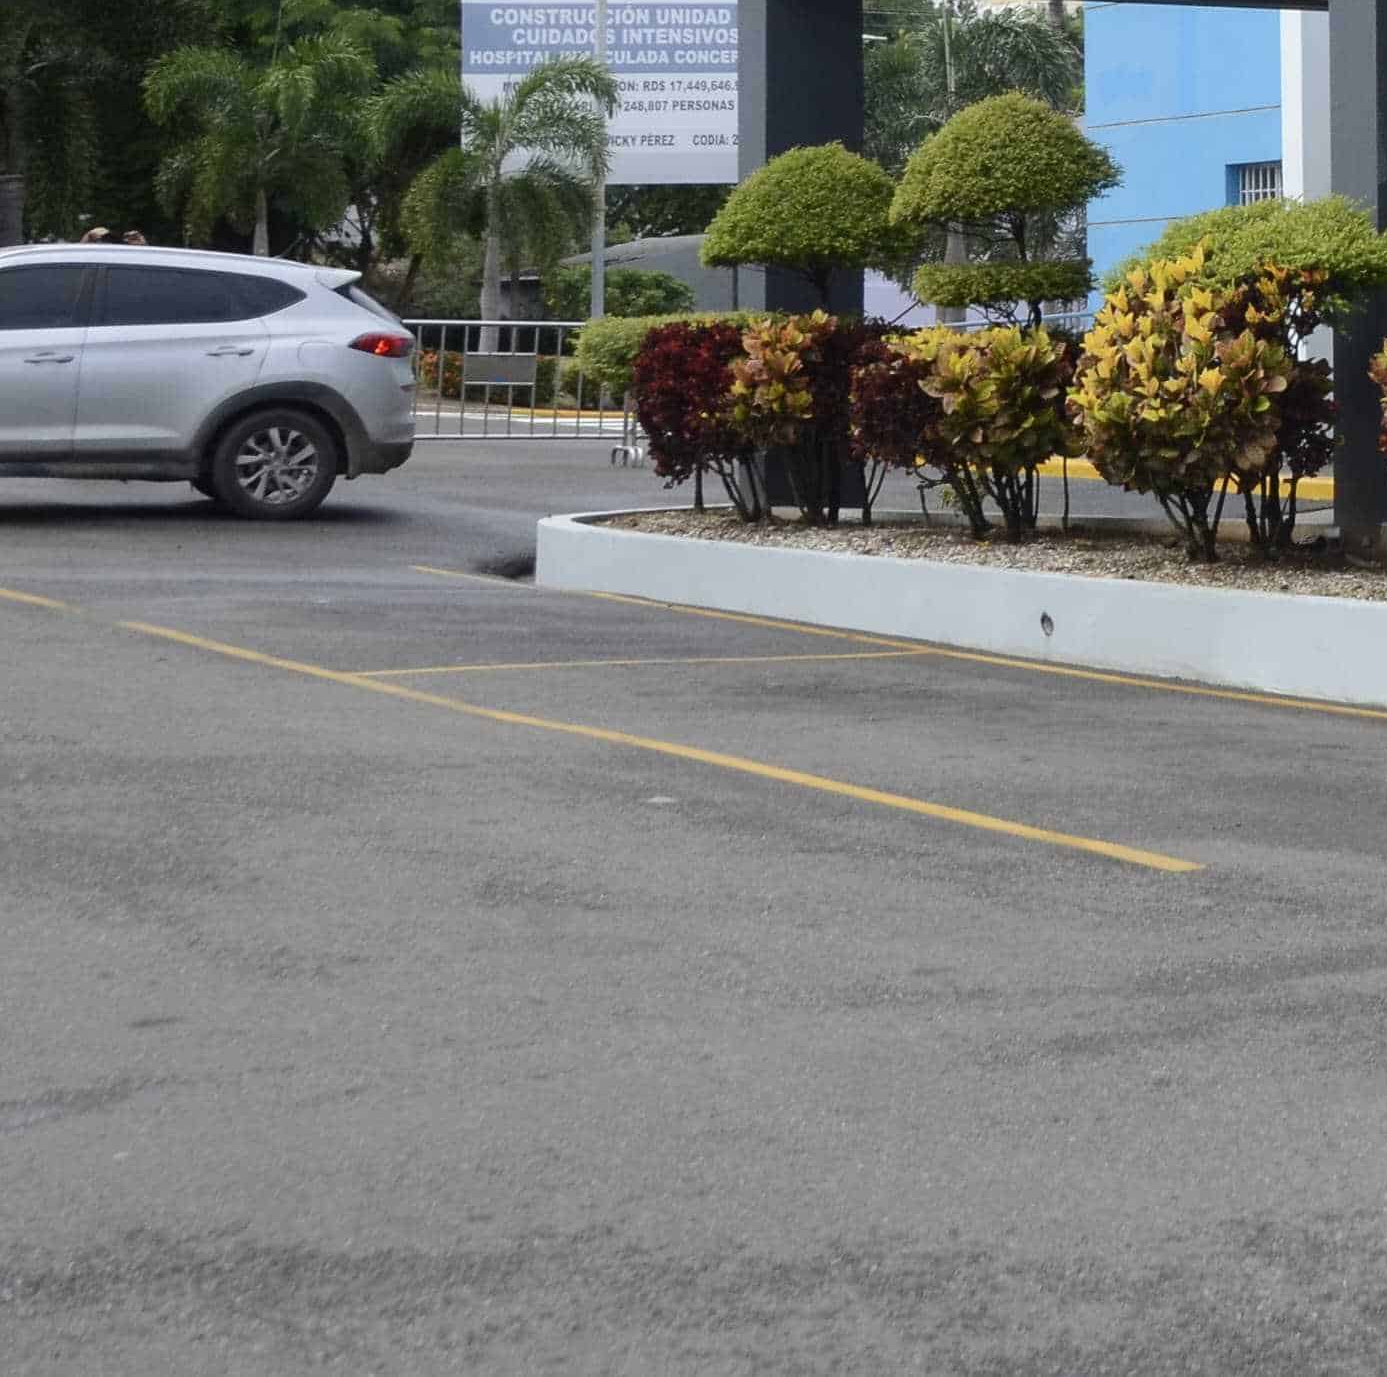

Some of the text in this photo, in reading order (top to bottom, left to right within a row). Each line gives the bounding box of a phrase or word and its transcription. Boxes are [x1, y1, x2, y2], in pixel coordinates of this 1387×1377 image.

[657, 8, 731, 25] UNIDAD
[623, 28, 738, 45] INTENSIVOS
[470, 50, 551, 65] HOSPITAL
[672, 99, 735, 111] PERSONAS
